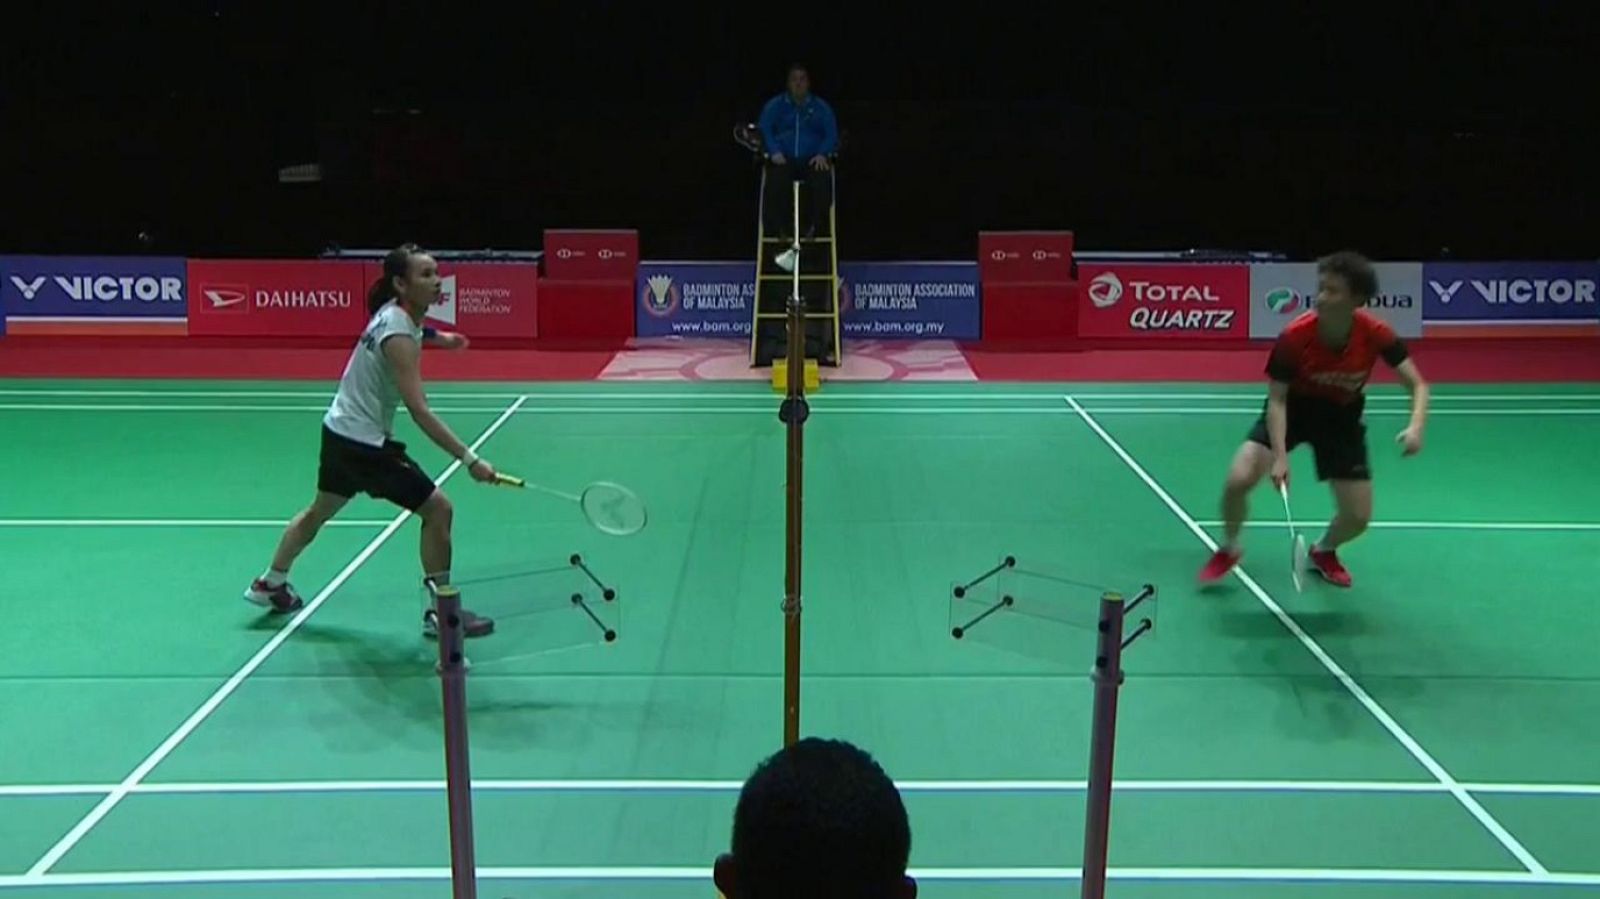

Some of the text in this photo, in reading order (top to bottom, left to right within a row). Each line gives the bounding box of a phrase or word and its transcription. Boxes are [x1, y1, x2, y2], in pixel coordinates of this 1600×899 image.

[54, 277, 182, 300] VICTOR
[683, 283, 740, 297] BADMINTON
[855, 283, 975, 297] BADMINTON ASSOCIATION
[1471, 279, 1596, 303] VICTOR
[255, 290, 350, 308] DAIHATSU
[683, 297, 745, 310] OF MALAYSIA
[855, 297, 918, 310] OF MALAYSIA
[1130, 307, 1234, 329] QUARTZ
[672, 321, 752, 335] www.bam.org
[844, 321, 944, 335] www.bam.org.my
